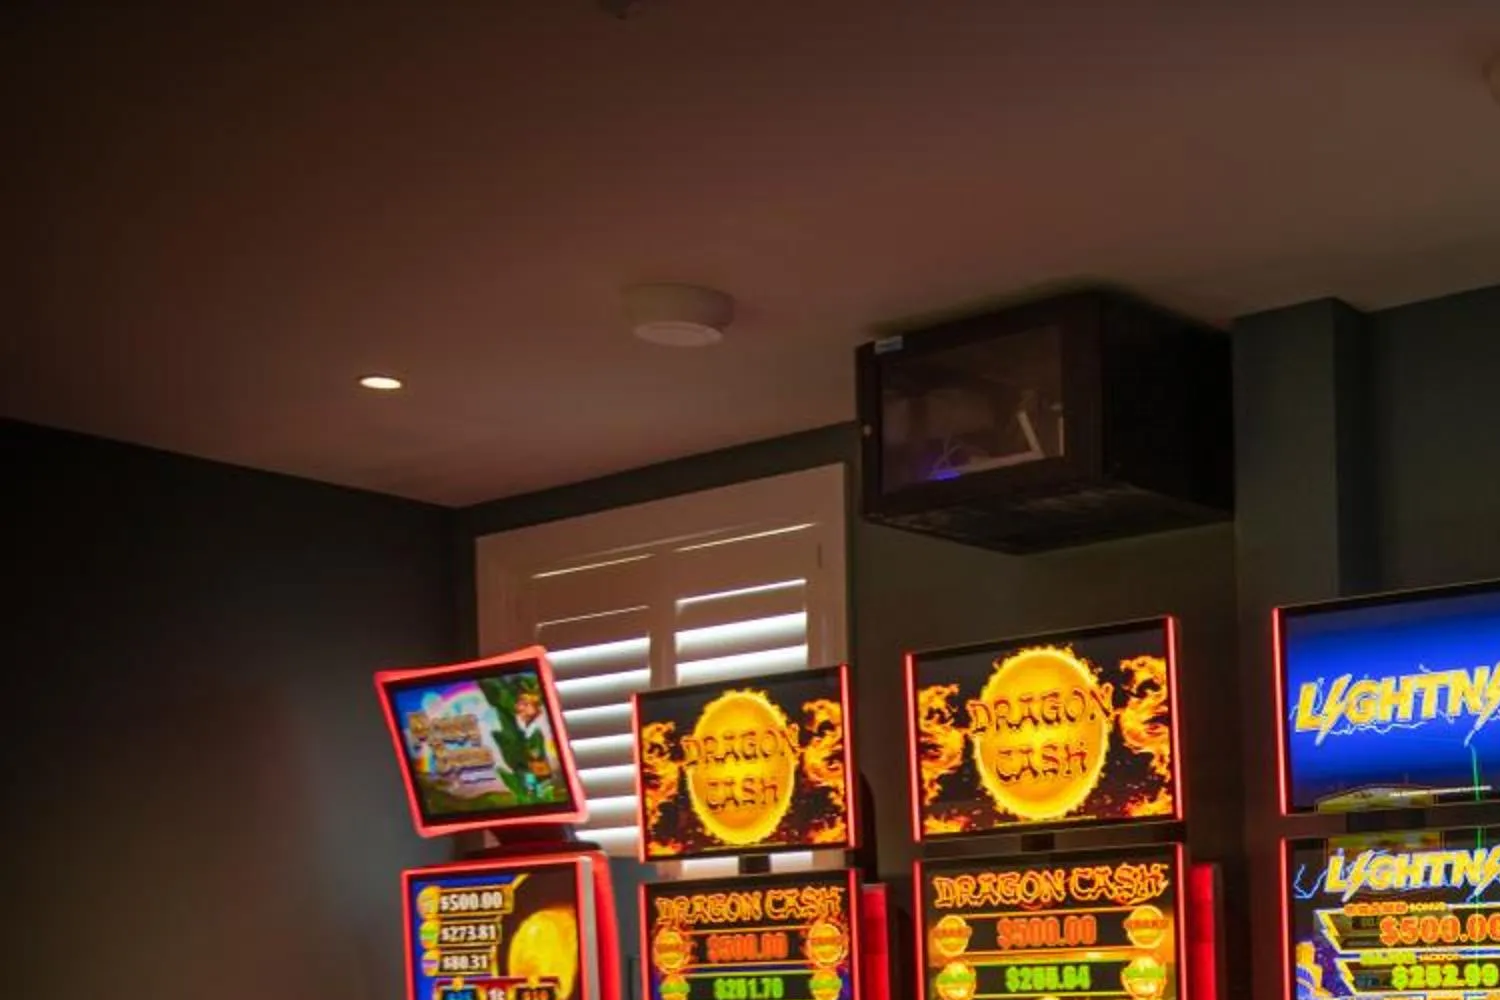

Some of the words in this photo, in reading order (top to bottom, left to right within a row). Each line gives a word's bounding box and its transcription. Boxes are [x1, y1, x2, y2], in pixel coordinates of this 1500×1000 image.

[967, 682, 1114, 735] DRAGON
[996, 741, 1089, 783] CASH
[440, 891, 503, 912] $500.00
[933, 869, 1067, 908] DRAGON
[1070, 863, 1168, 902] CASH
[766, 886, 845, 920] CASH
[441, 925, 496, 942] $273.81
[997, 915, 1097, 949] $500.00
